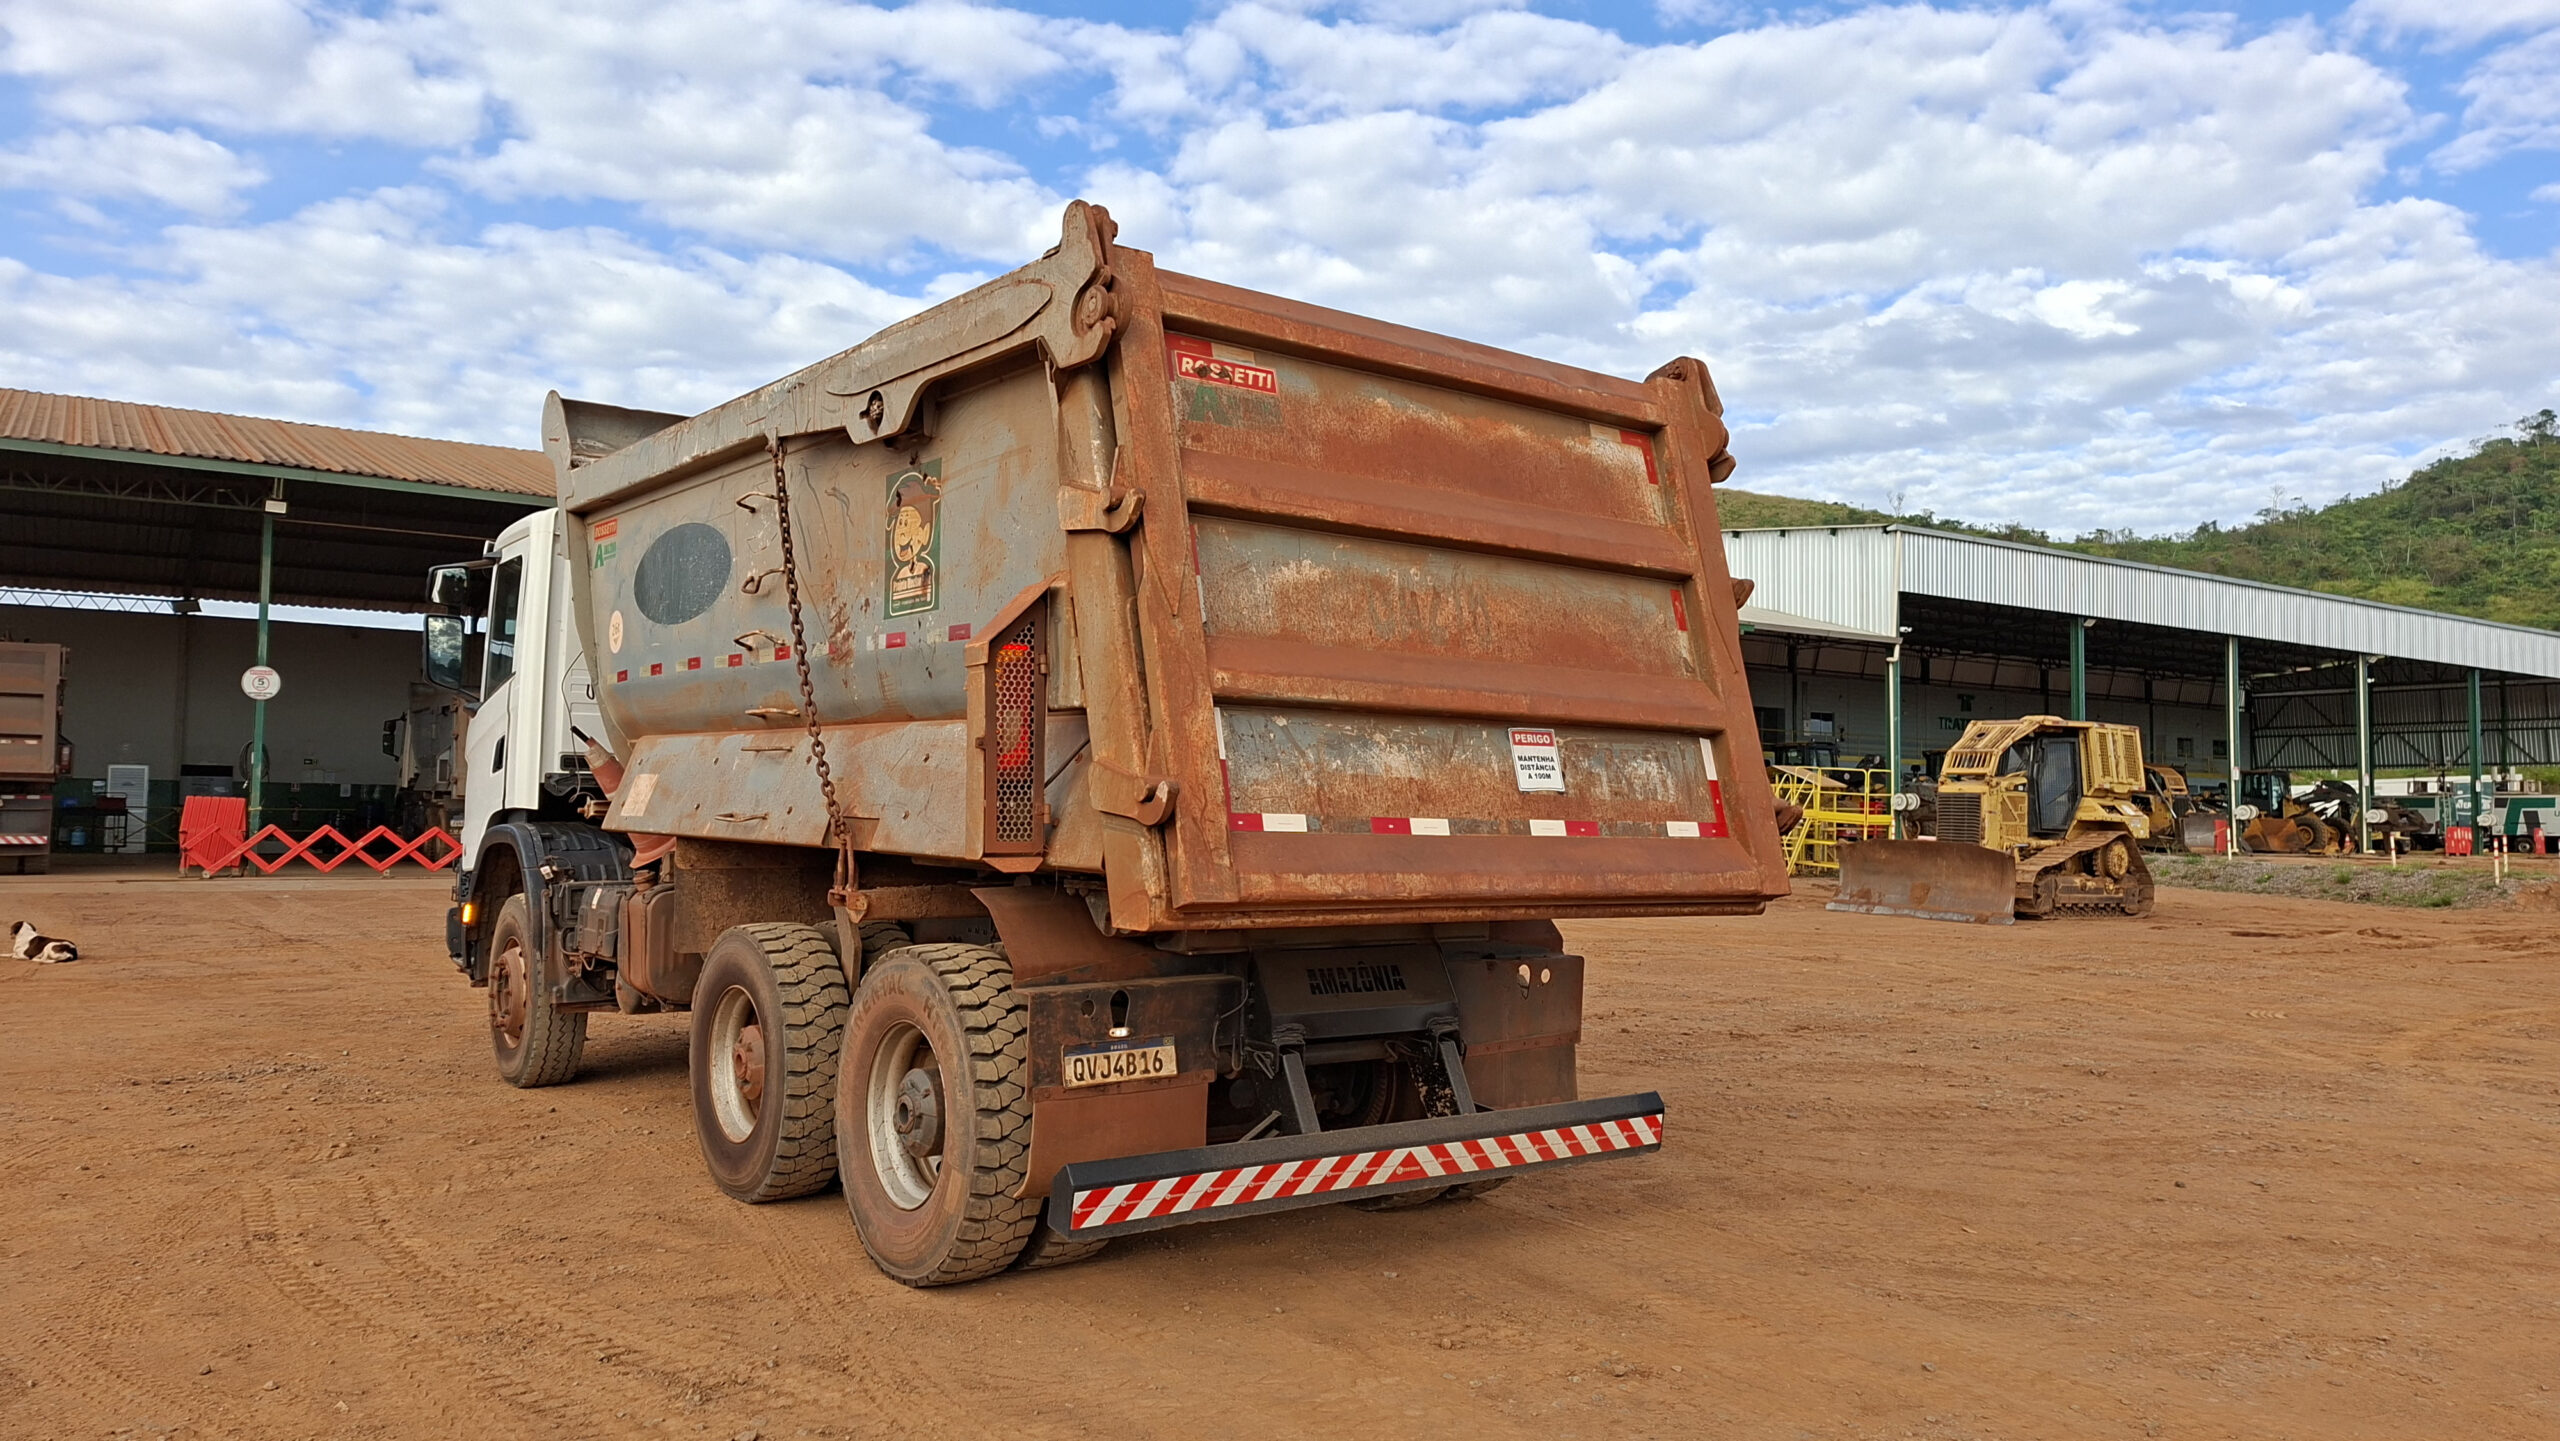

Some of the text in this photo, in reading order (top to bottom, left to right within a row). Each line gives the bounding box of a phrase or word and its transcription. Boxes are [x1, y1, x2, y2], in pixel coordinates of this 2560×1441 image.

[1938, 716, 1969, 730] TRAT
[1514, 733, 1551, 744] PERIGO
[1519, 763, 1556, 771] DISTÂNCIA
[1306, 961, 1407, 995] AMAZÔNIA
[1073, 1049, 1163, 1082] QVJ4B16
